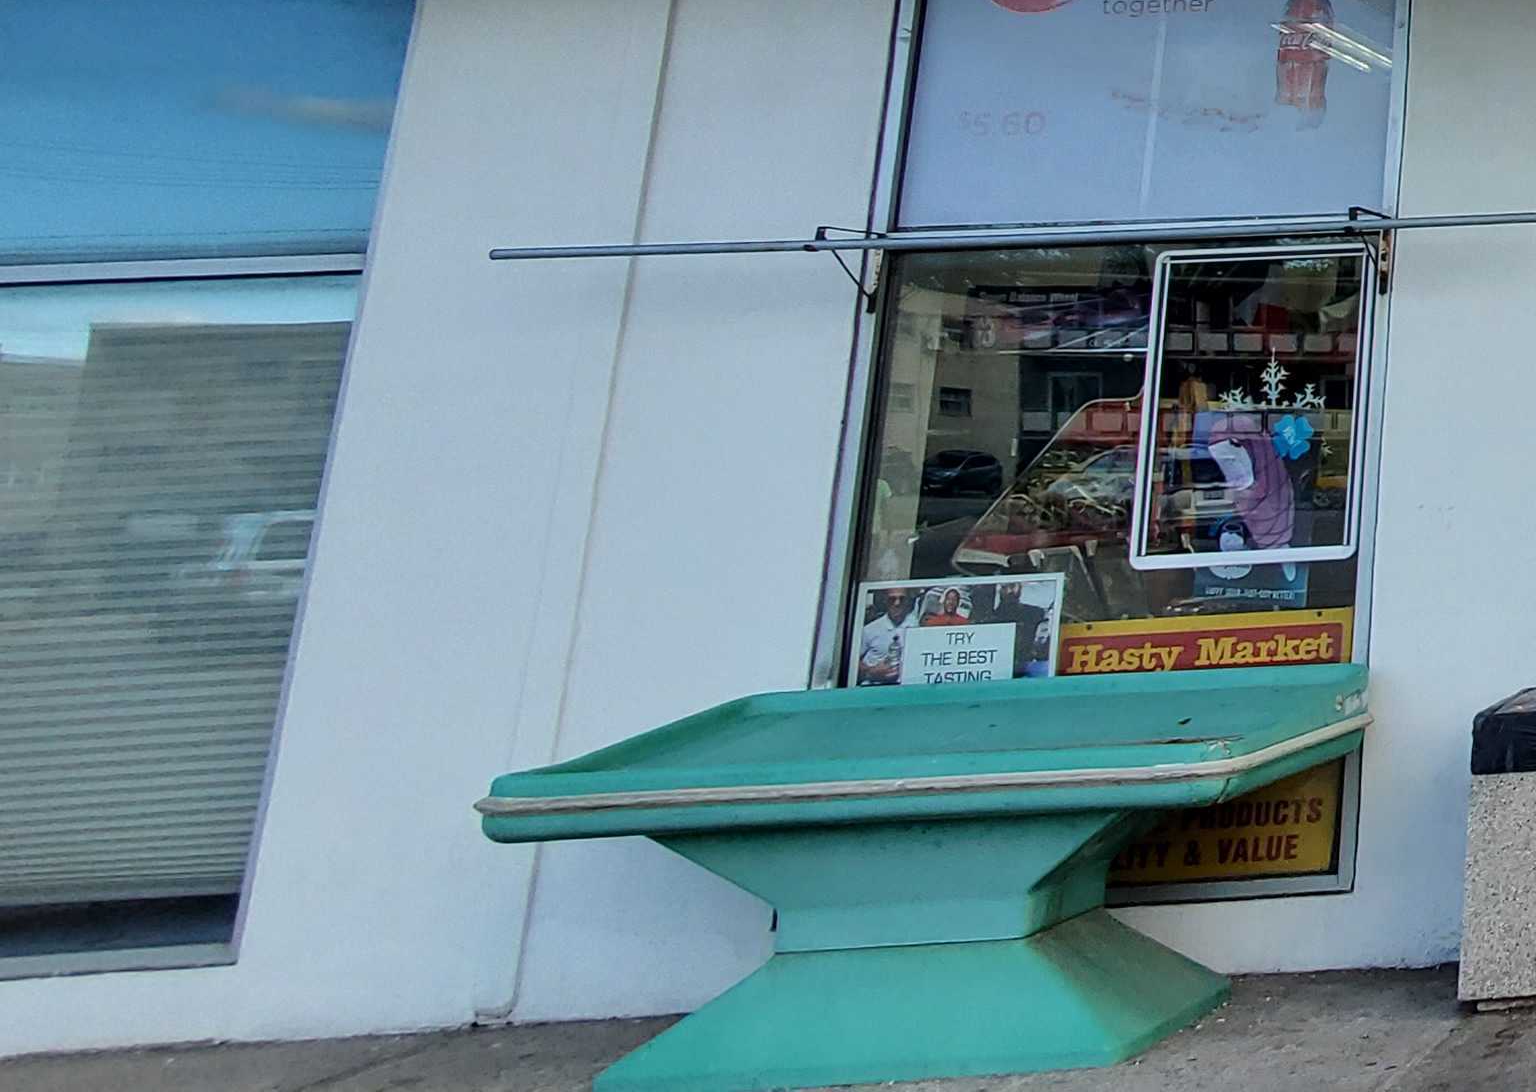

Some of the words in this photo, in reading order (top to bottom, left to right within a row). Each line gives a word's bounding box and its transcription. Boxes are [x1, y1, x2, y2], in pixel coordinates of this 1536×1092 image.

[946, 632, 975, 645] TRY
[921, 651, 952, 667] THE
[956, 649, 998, 666] BEST
[1065, 642, 1185, 673] Hasty
[1194, 631, 1334, 667] Market
[924, 670, 992, 685] TASTING
[1182, 797, 1323, 830] PRODUCTS
[1183, 839, 1201, 866] &
[1216, 834, 1299, 865] VALUE
